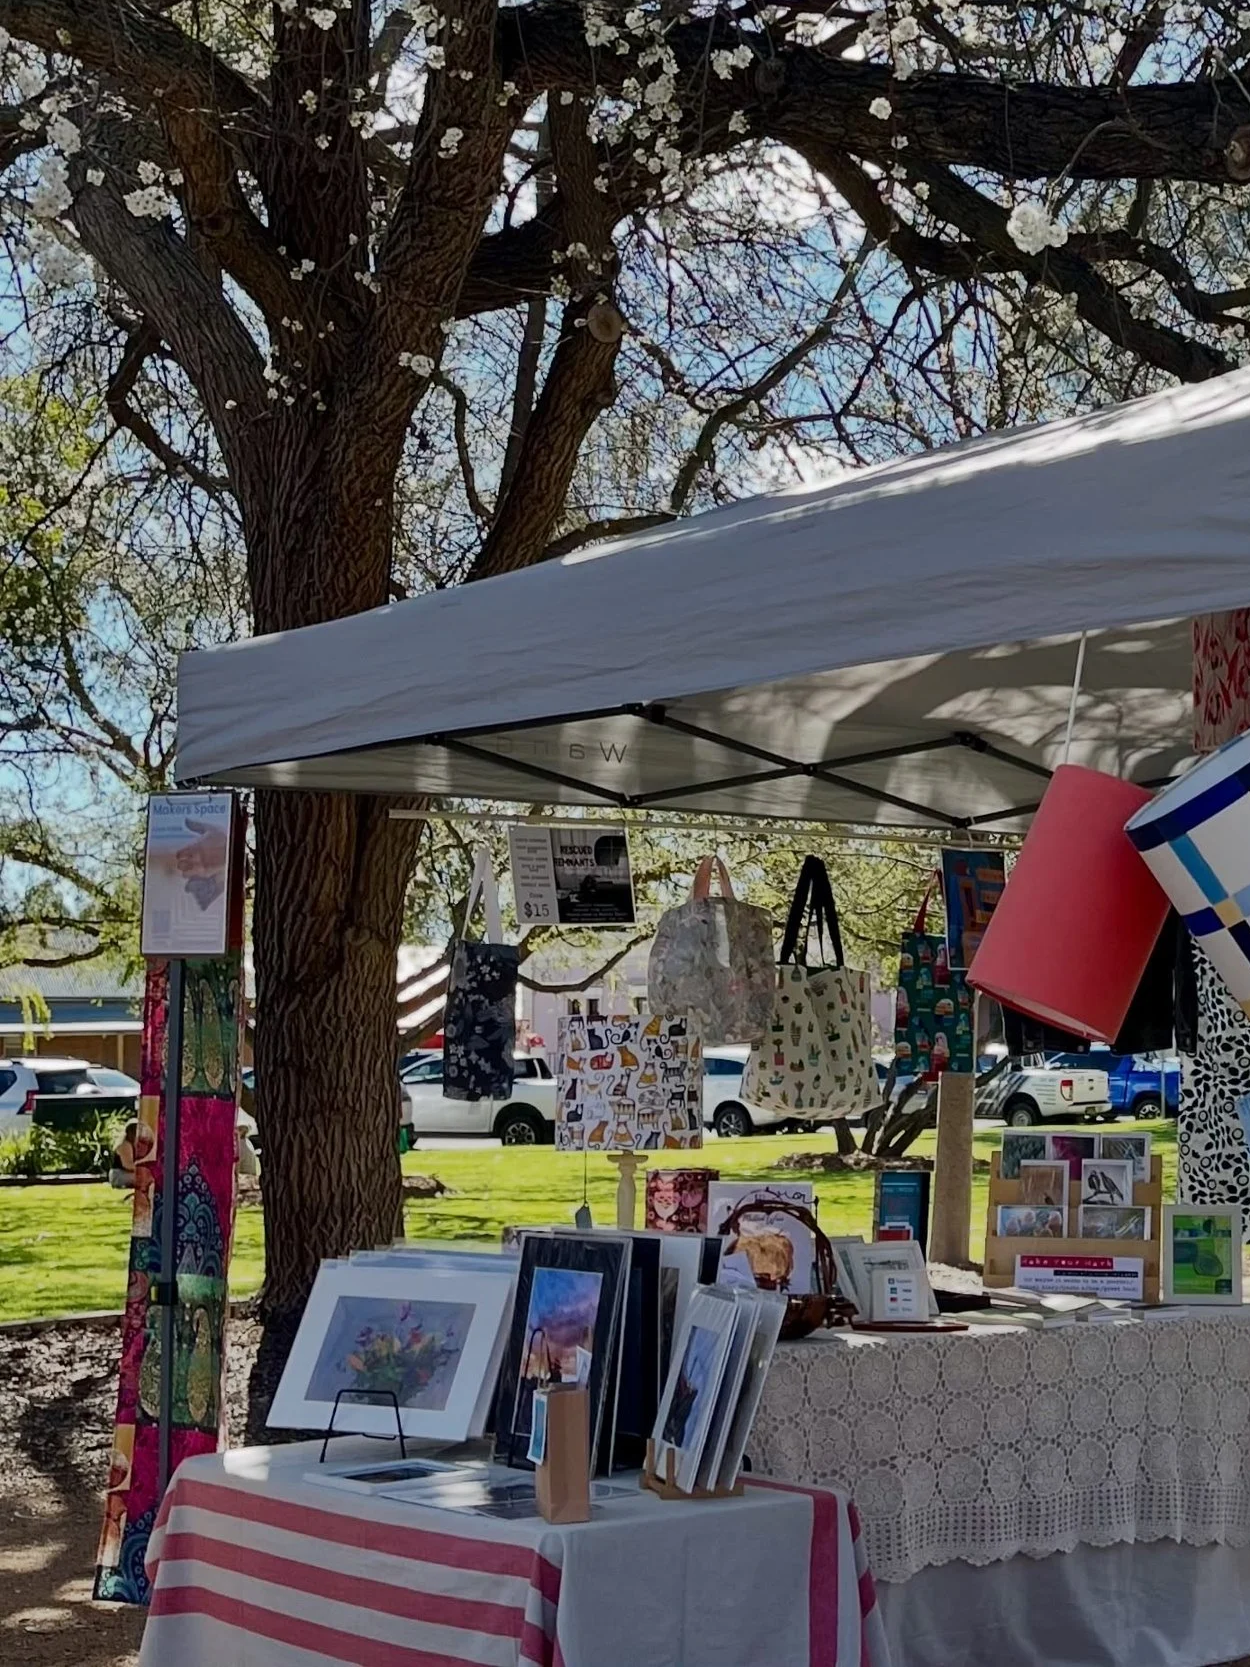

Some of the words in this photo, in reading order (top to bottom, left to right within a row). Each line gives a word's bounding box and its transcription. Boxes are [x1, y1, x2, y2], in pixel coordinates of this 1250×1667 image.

[194, 804, 226, 818] Space
[560, 845, 593, 855] RESCUED
[524, 901, 550, 919] $15
